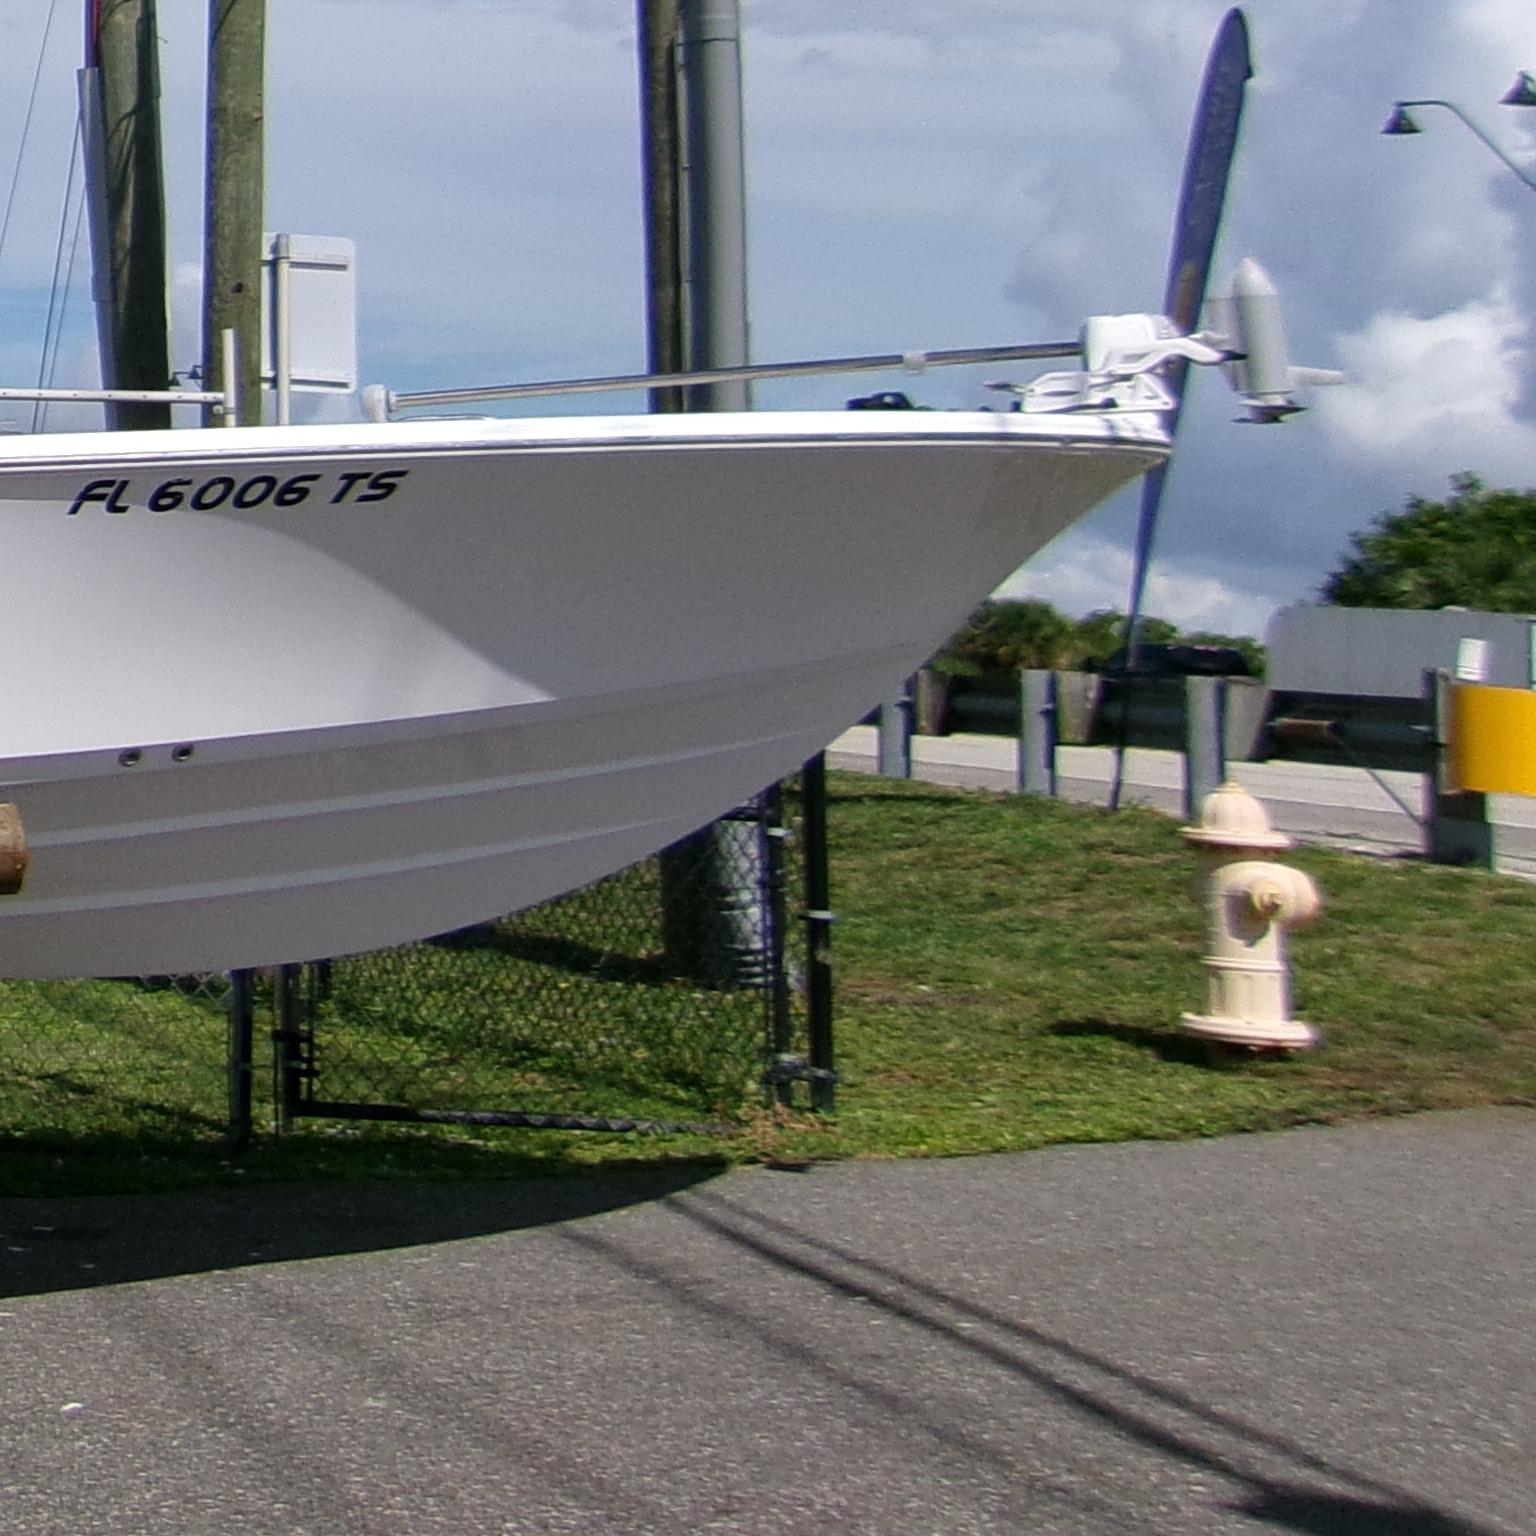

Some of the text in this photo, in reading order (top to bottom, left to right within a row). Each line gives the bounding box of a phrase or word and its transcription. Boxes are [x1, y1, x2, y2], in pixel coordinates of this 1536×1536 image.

[67, 469, 410, 515] FL 6006 TS
